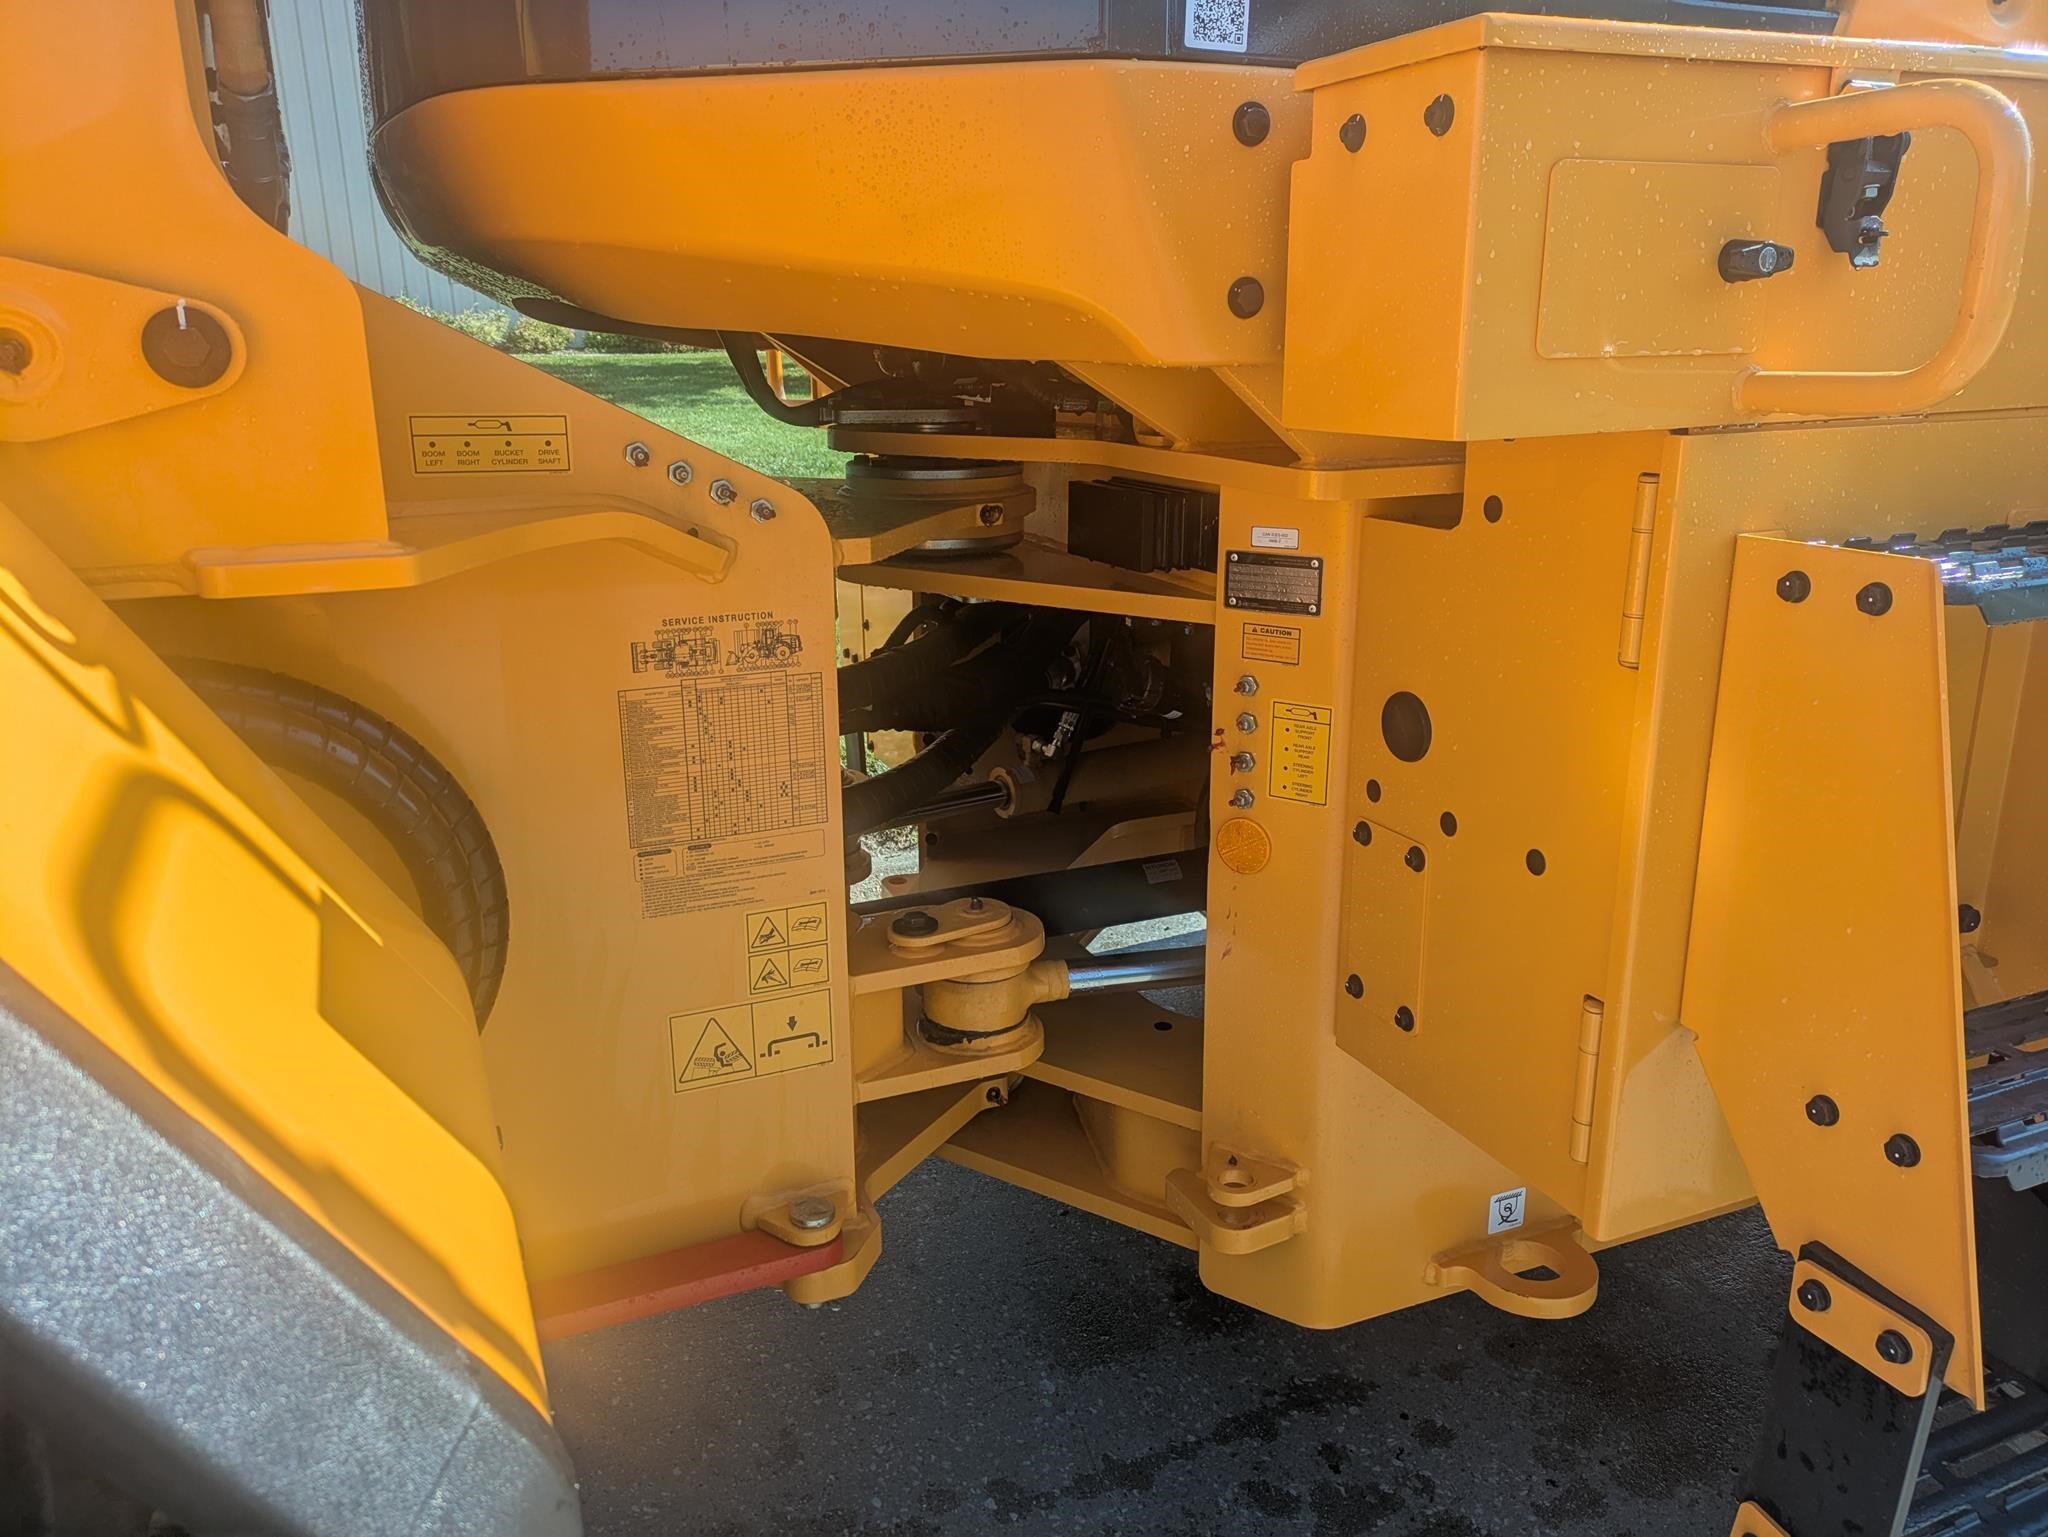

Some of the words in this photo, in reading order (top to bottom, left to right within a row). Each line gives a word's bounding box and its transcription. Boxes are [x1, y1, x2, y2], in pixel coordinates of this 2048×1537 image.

[662, 616, 704, 627] SERVICE
[708, 611, 774, 624] INSTRUCTION
[1260, 628, 1292, 636] CAUTION
